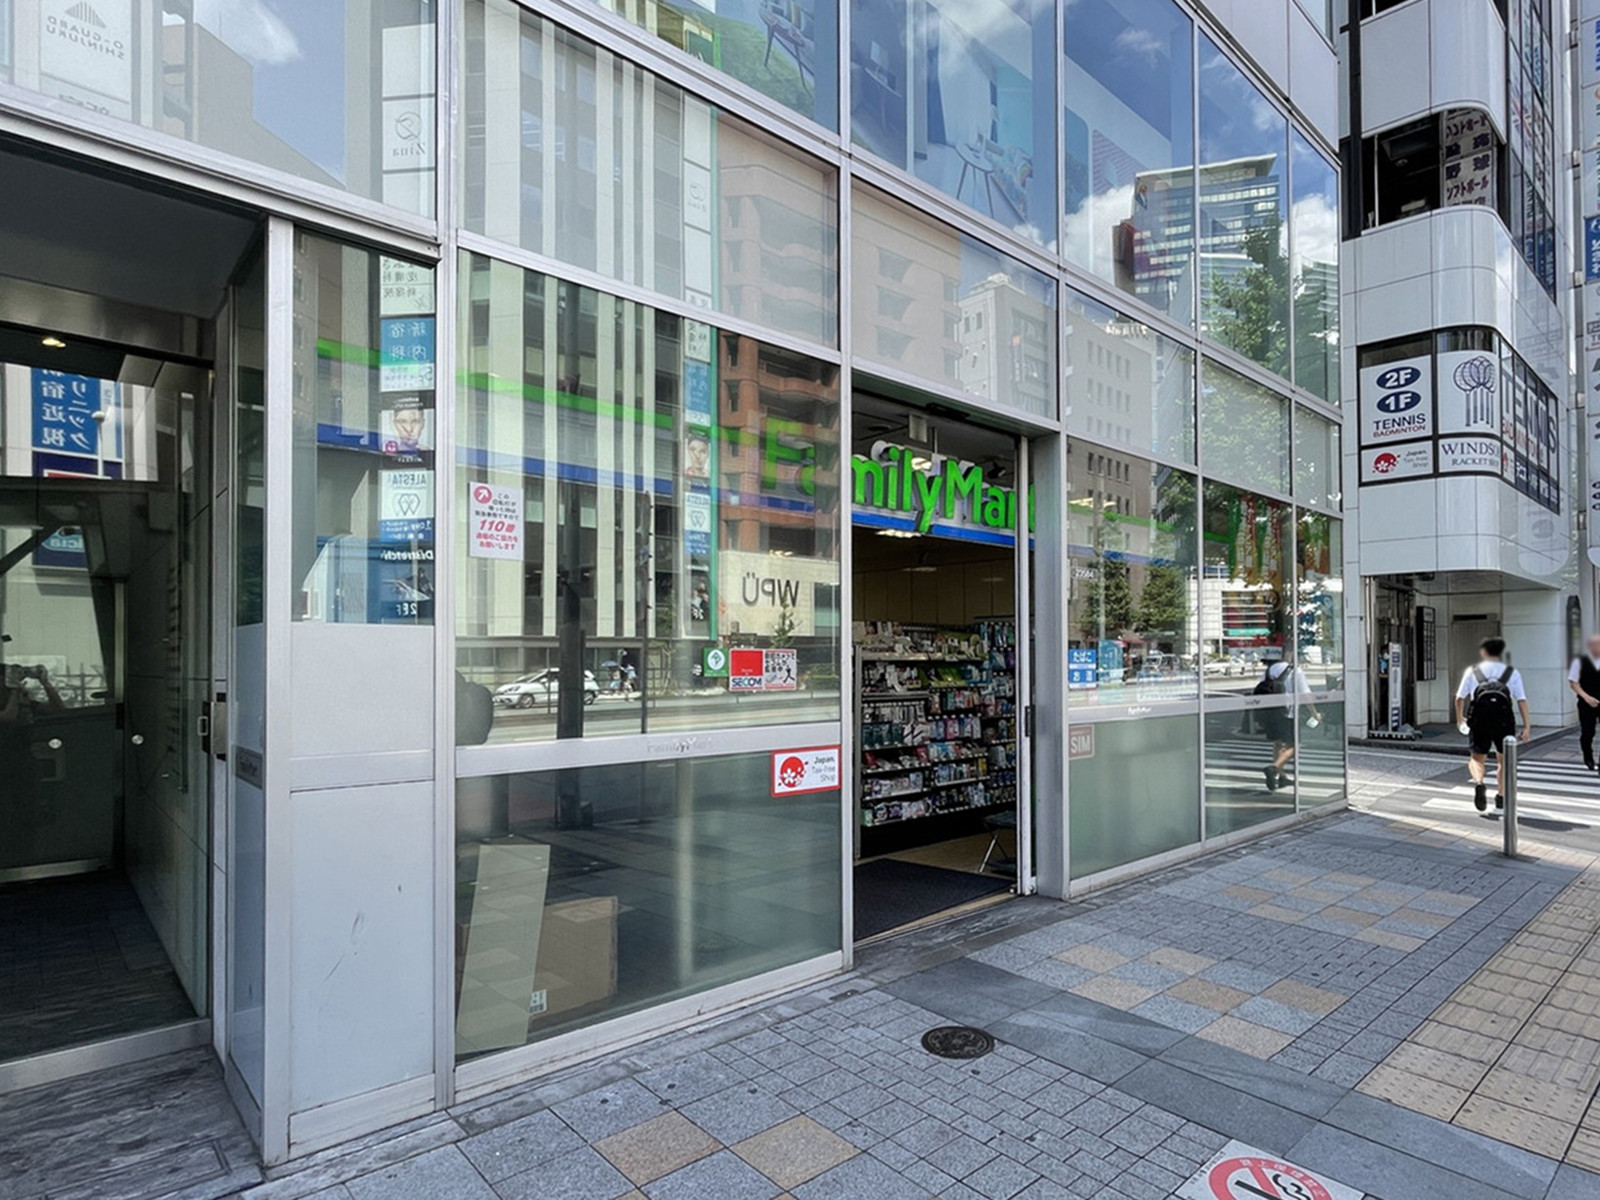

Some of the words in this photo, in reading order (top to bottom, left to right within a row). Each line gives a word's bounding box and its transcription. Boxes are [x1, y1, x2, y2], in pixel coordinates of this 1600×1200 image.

[1385, 368, 1412, 387] 2F
[1385, 393, 1412, 411] 1F
[1373, 413, 1426, 431] TENNIS
[1373, 424, 1426, 438] BADMINTON
[1451, 457, 1487, 466] RACKET
[731, 677, 762, 687] SECOM
[1071, 735, 1091, 754] SIM
